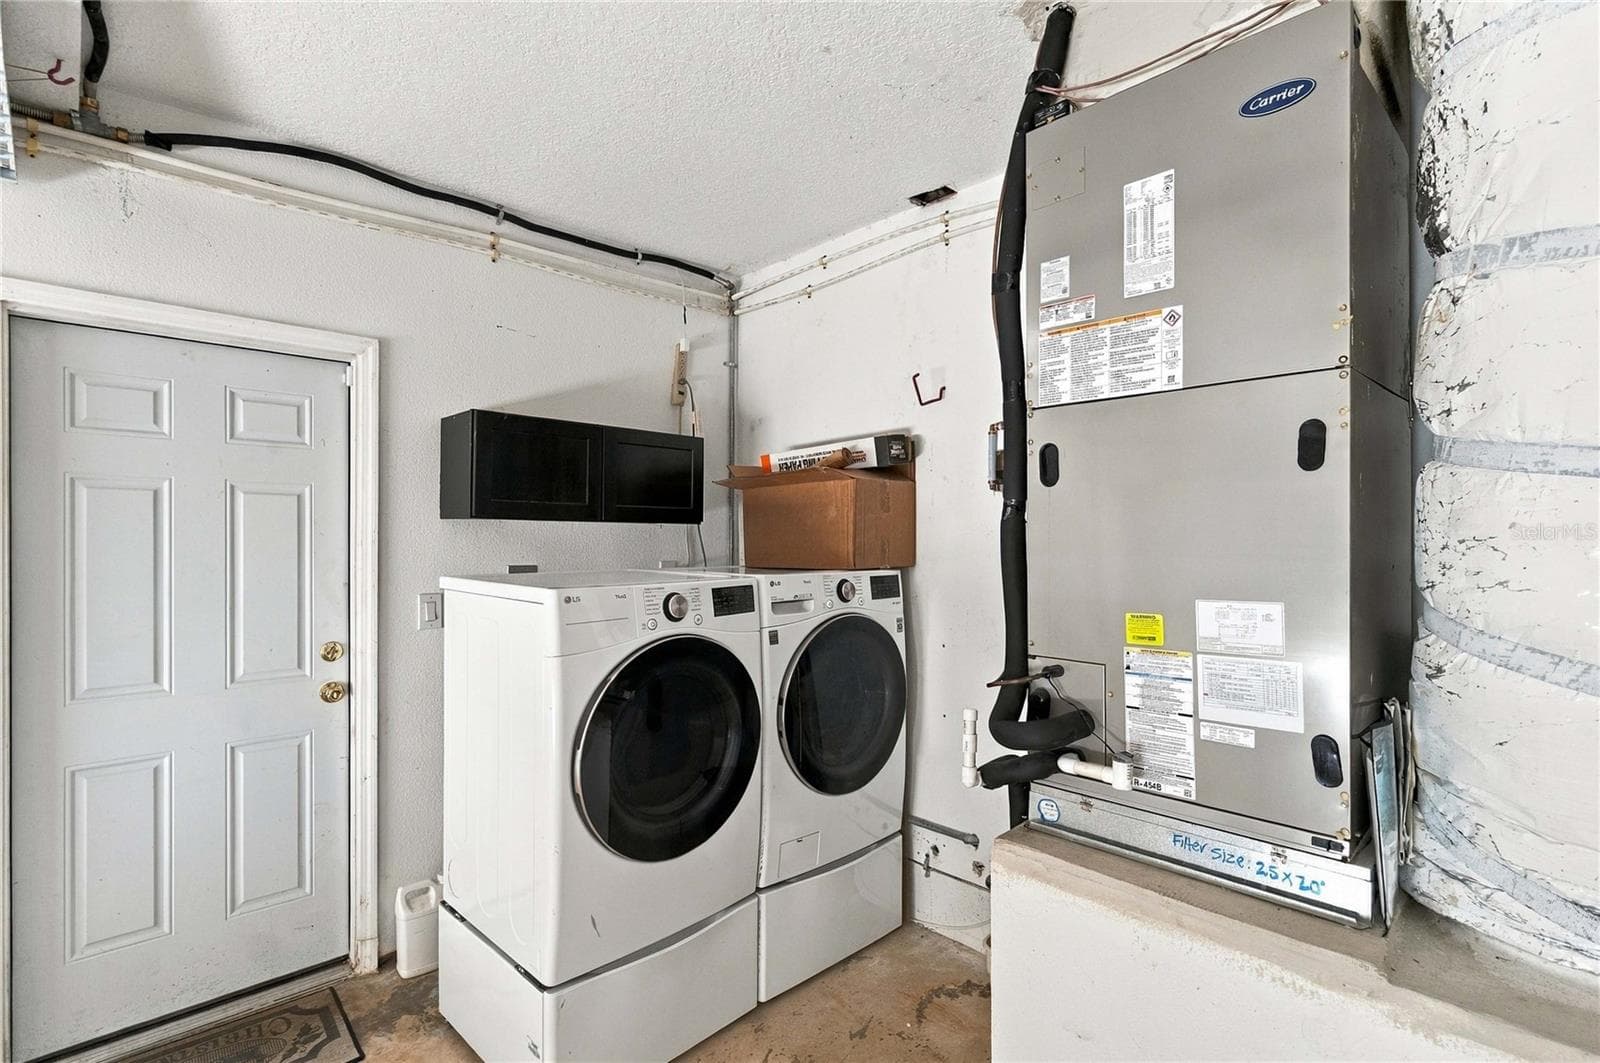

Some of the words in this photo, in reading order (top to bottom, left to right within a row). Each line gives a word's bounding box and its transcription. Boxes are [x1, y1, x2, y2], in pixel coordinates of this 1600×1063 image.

[1249, 84, 1305, 111] Carrier
[1133, 778, 1162, 791] R-454B
[1172, 832, 1207, 854] Filter
[1255, 861, 1279, 880] 25
